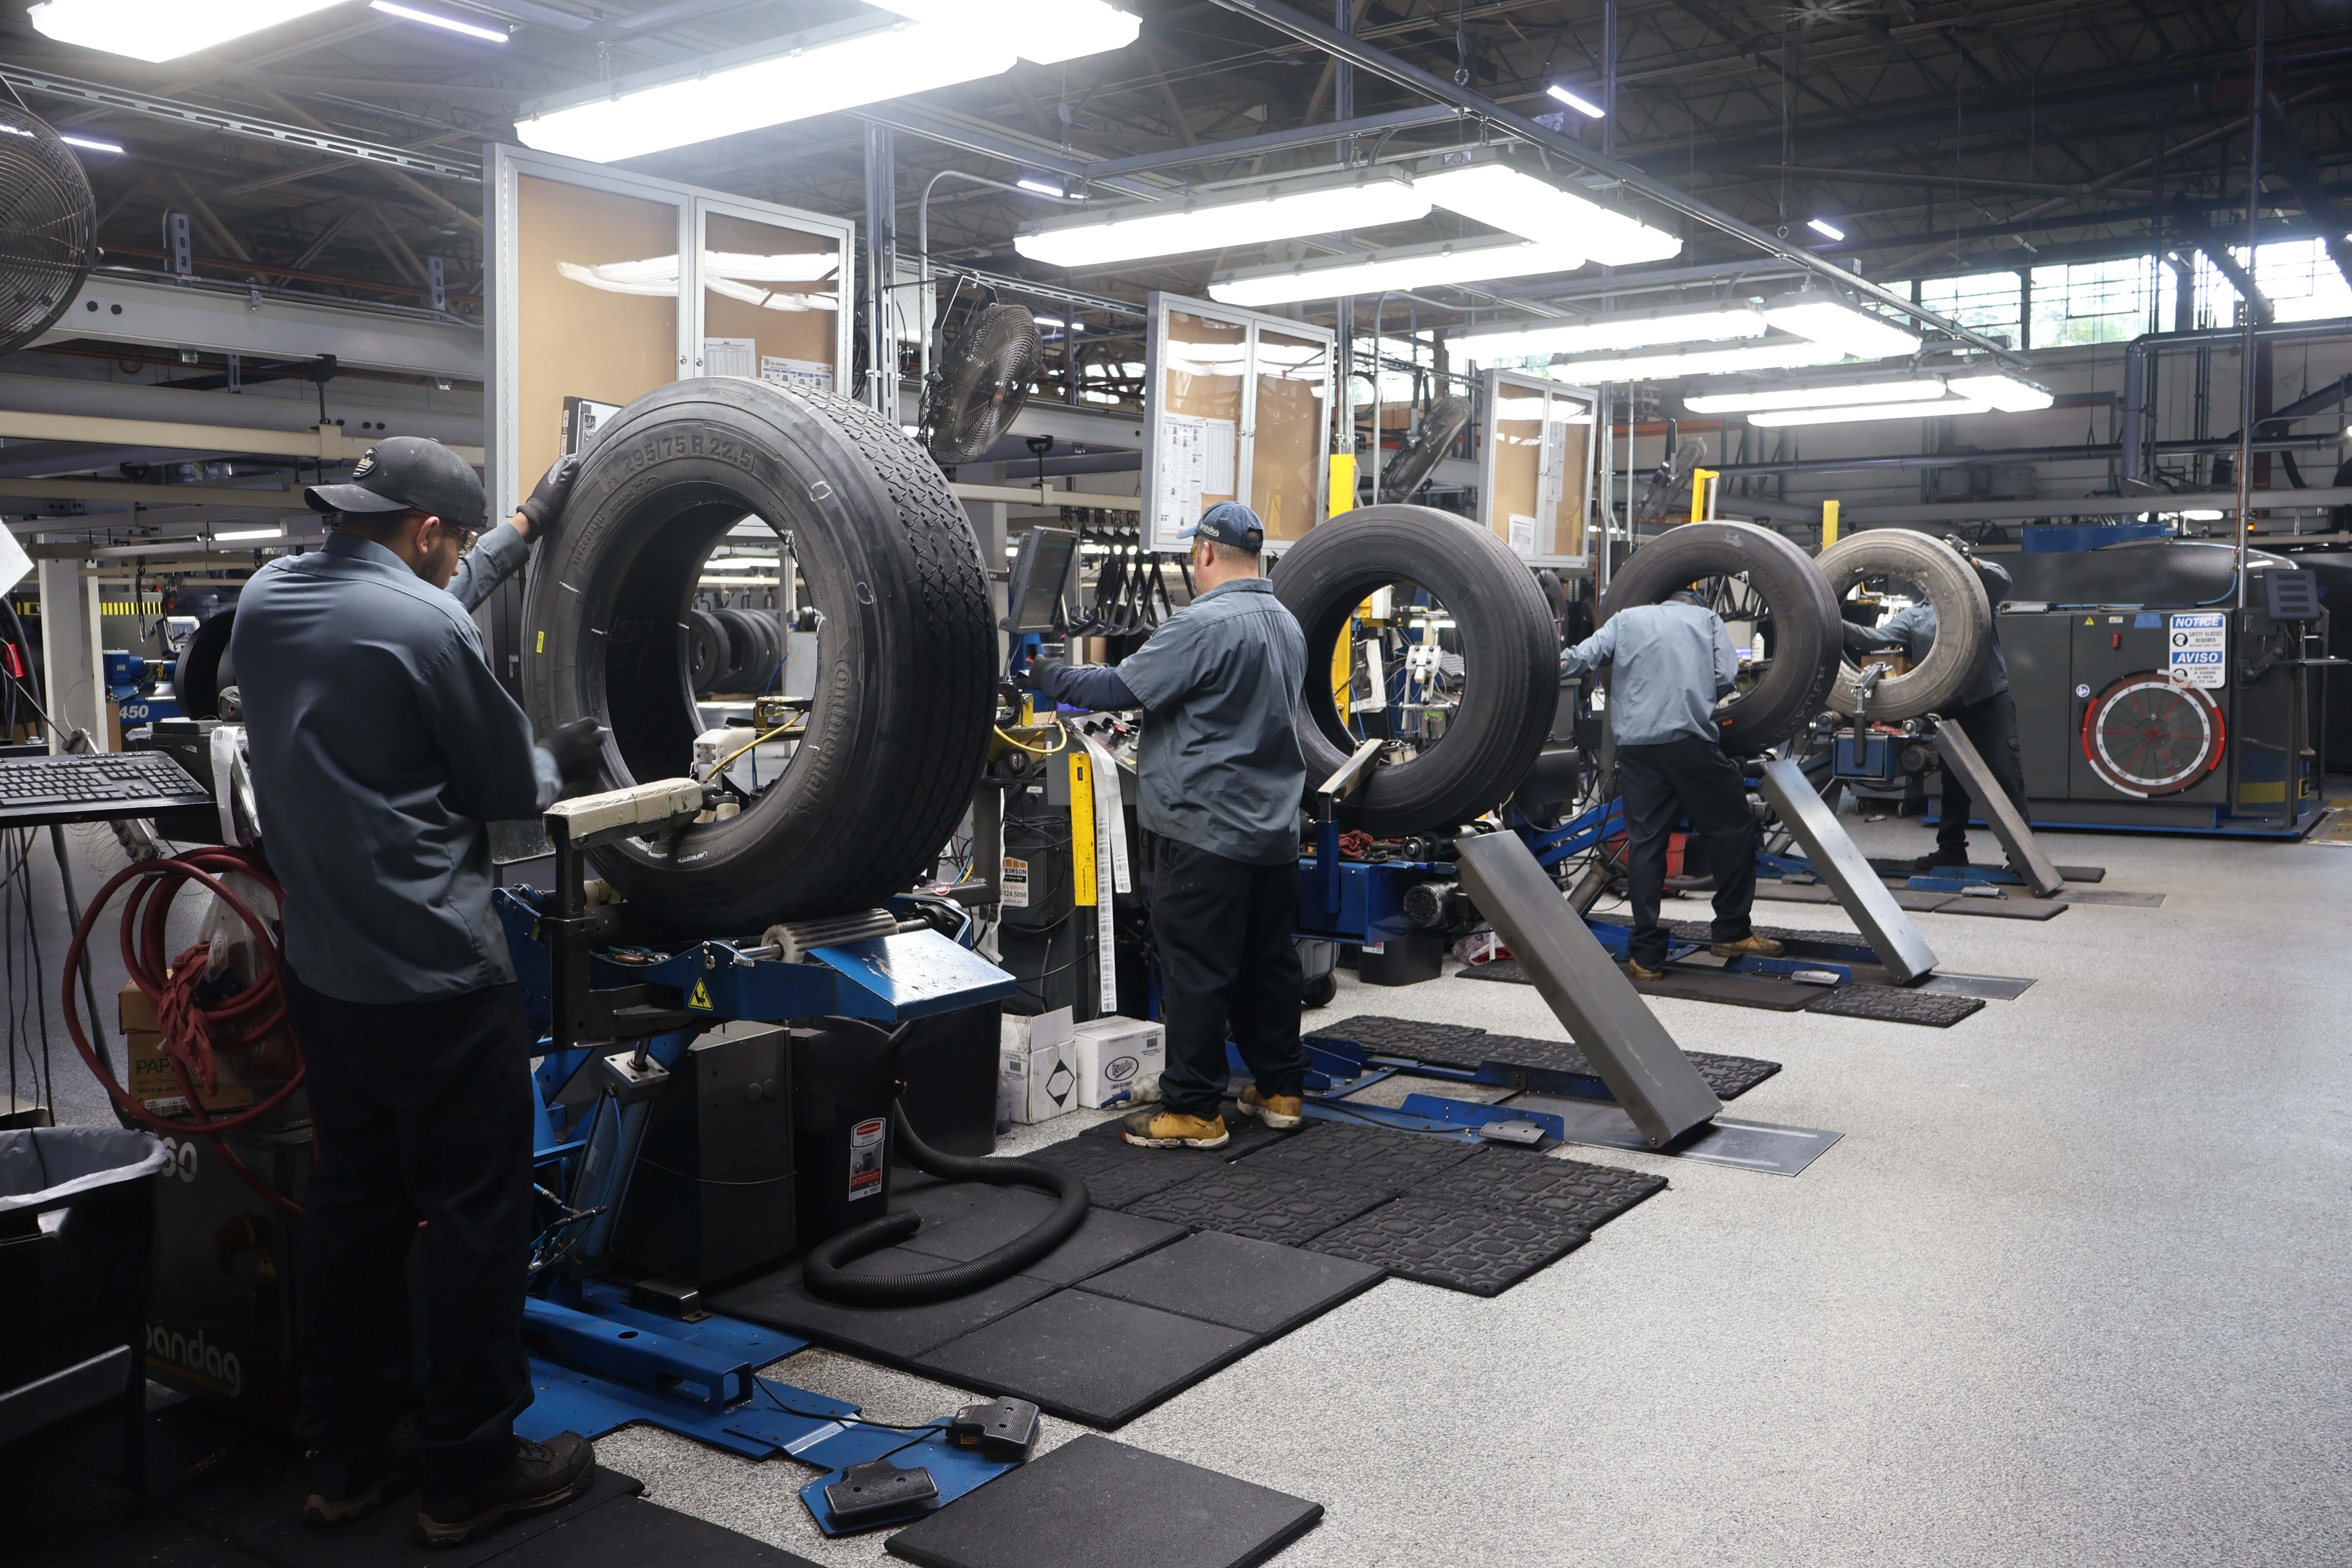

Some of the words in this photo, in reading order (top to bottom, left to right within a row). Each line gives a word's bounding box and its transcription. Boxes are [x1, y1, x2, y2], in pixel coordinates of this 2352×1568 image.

[622, 436, 686, 476] 295/75
[691, 436, 705, 456] R
[710, 437, 753, 470] 22.5
[1200, 523, 1220, 537] bandag
[2175, 617, 2220, 627] NOTICE
[2176, 652, 2218, 663] AVISO
[119, 705, 149, 719] 450
[802, 660, 851, 802] Continental
[136, 1058, 175, 1075] PAP
